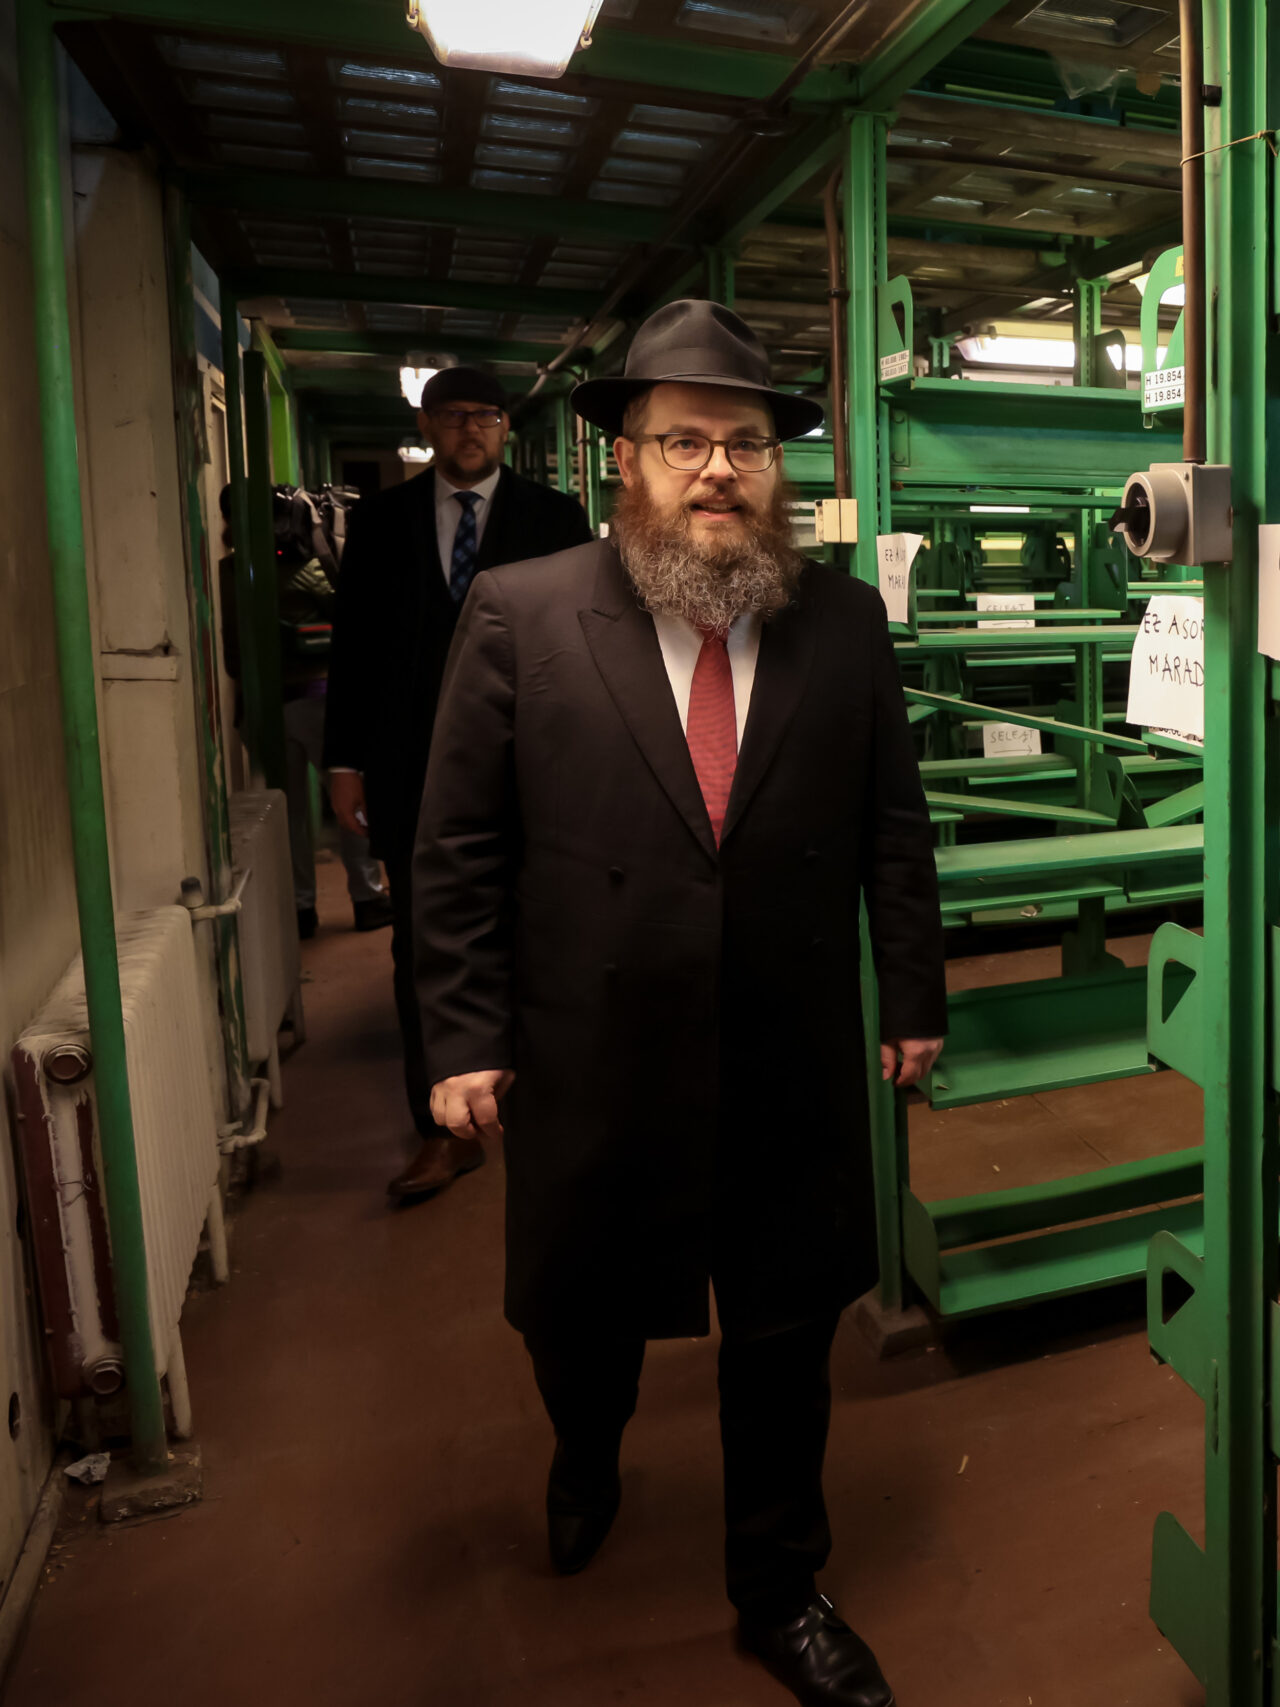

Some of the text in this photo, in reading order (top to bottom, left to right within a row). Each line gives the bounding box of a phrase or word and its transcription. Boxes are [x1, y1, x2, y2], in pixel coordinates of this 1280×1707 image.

[1145, 375, 1151, 385] H
[1145, 393, 1151, 404] H
[1144, 612, 1162, 634] EZ
[1167, 613, 1180, 636] A
[1149, 653, 1204, 687] MARAD
